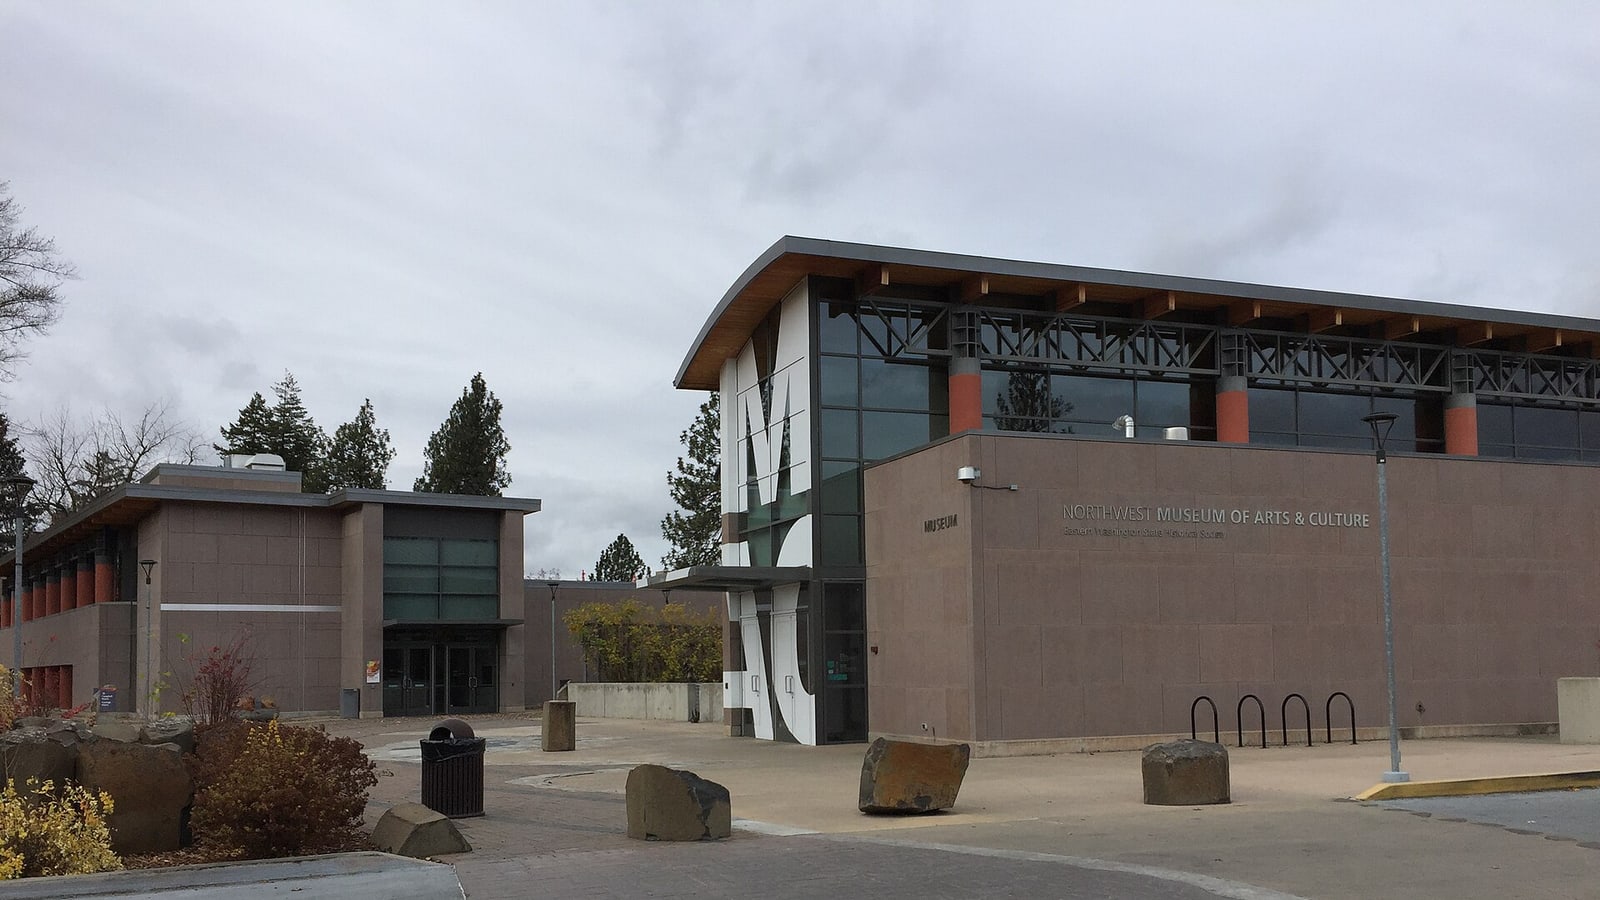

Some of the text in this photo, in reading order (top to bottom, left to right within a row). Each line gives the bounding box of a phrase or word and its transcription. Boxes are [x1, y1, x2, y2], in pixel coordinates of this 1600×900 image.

[924, 513, 958, 533] MUSEUM
[1062, 504, 1370, 527] NORTHWEST MUSEUM OF ARTS & CULTURE
[1064, 527, 1092, 536] Eastern
[1094, 527, 1141, 539] Washington
[1143, 527, 1163, 537] State
